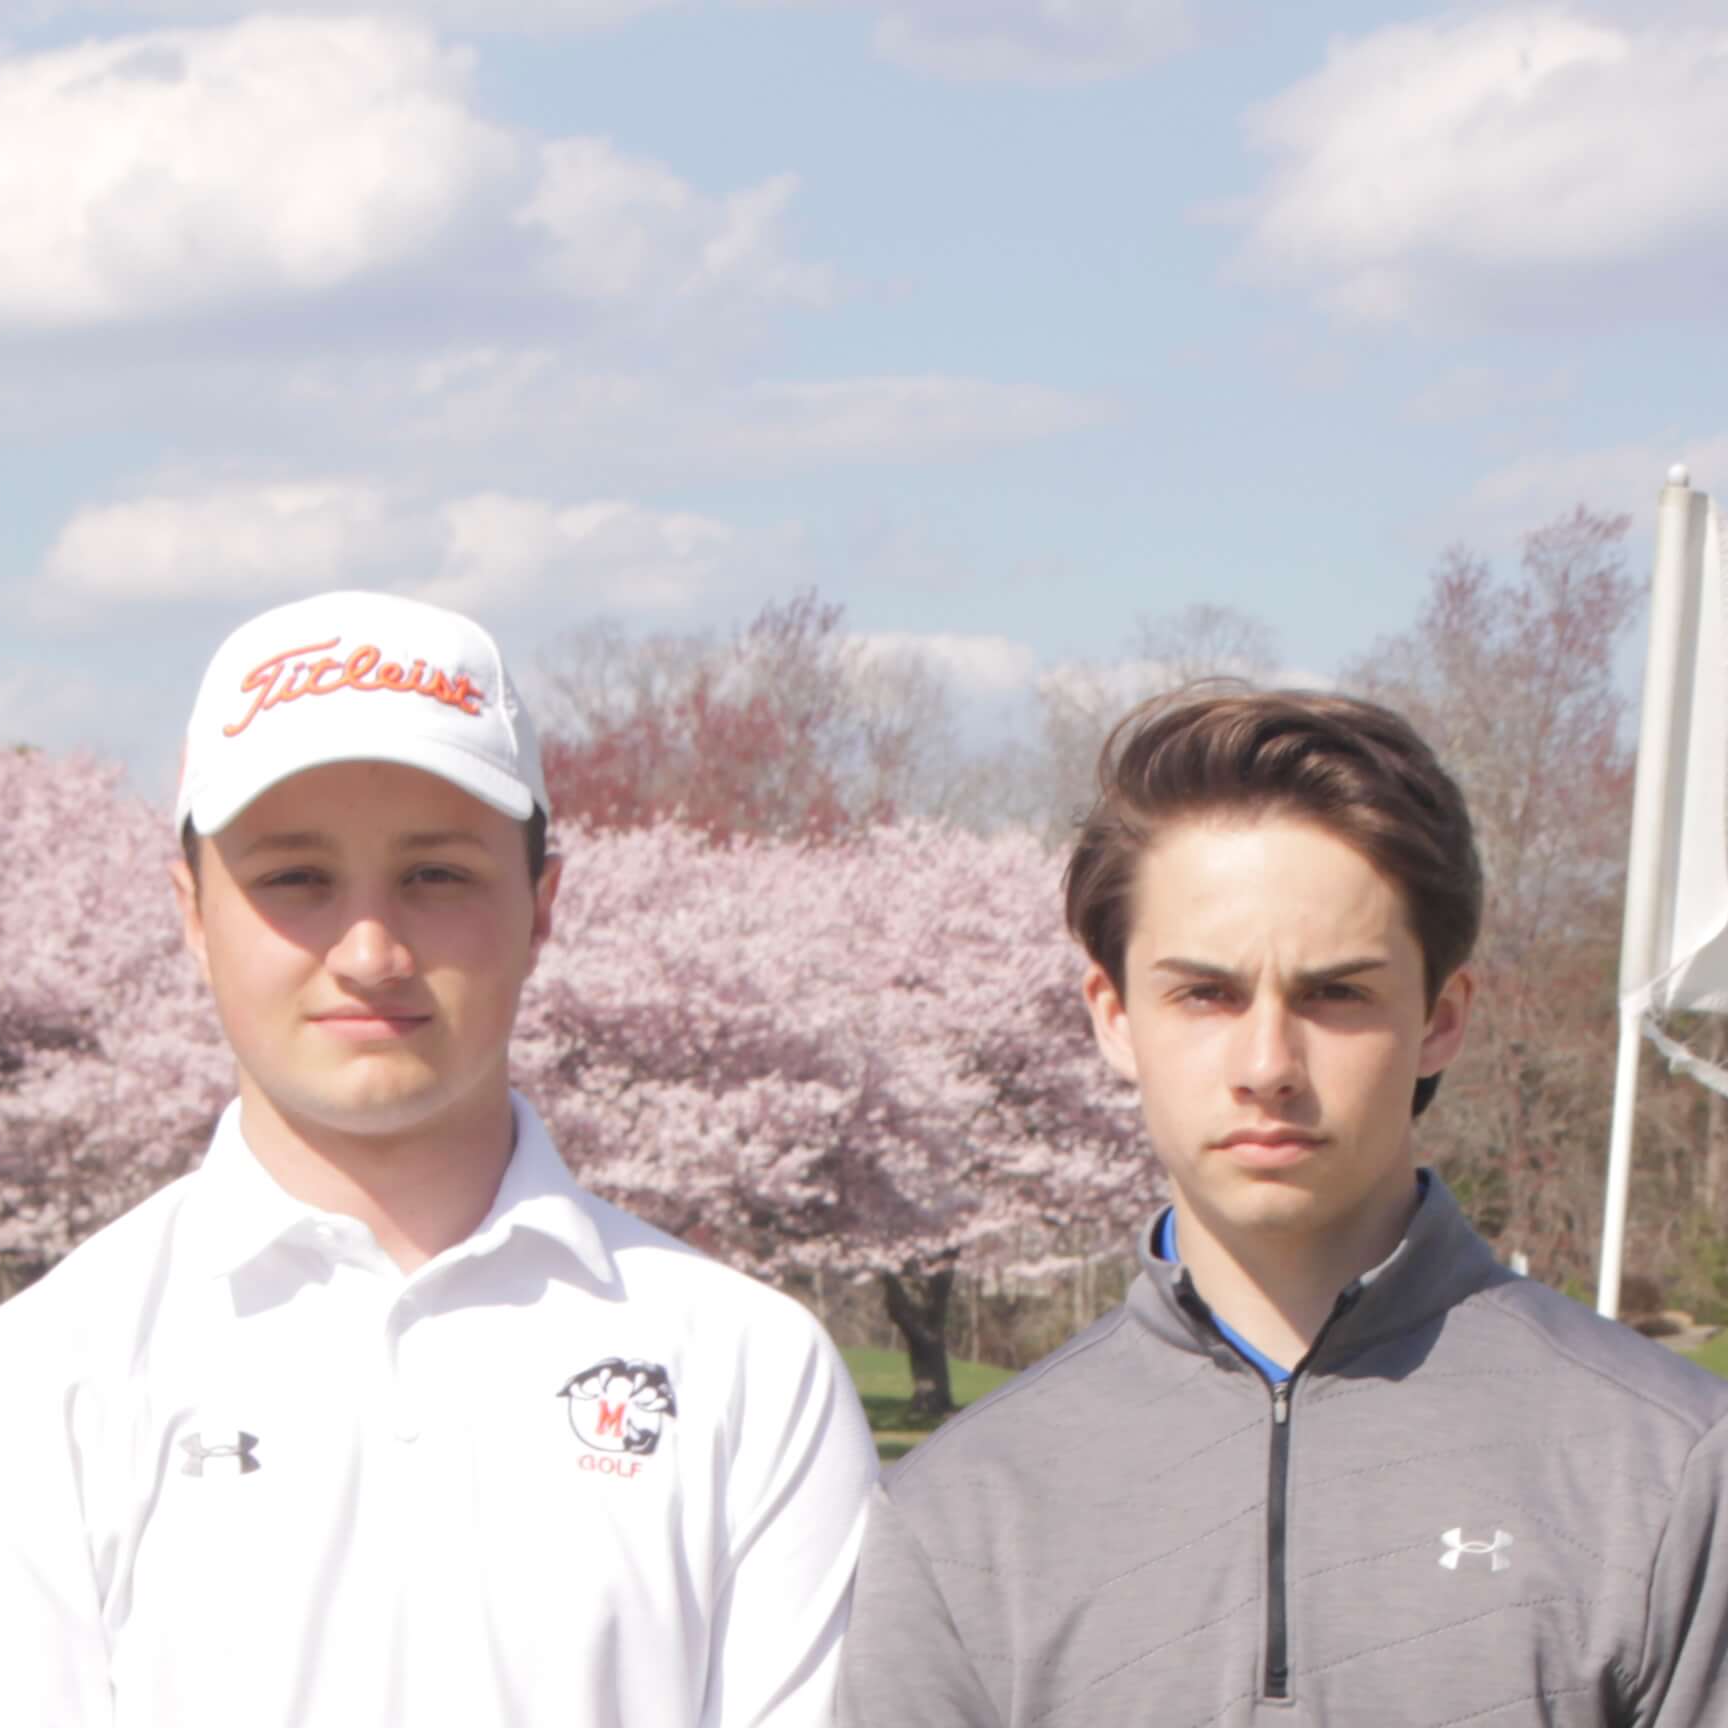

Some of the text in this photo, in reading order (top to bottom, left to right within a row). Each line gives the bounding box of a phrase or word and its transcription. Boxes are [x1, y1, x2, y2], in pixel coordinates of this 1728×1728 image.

[223, 637, 484, 737] Titleist
[595, 1399, 626, 1438] M
[578, 1454, 642, 1479] GOLF
